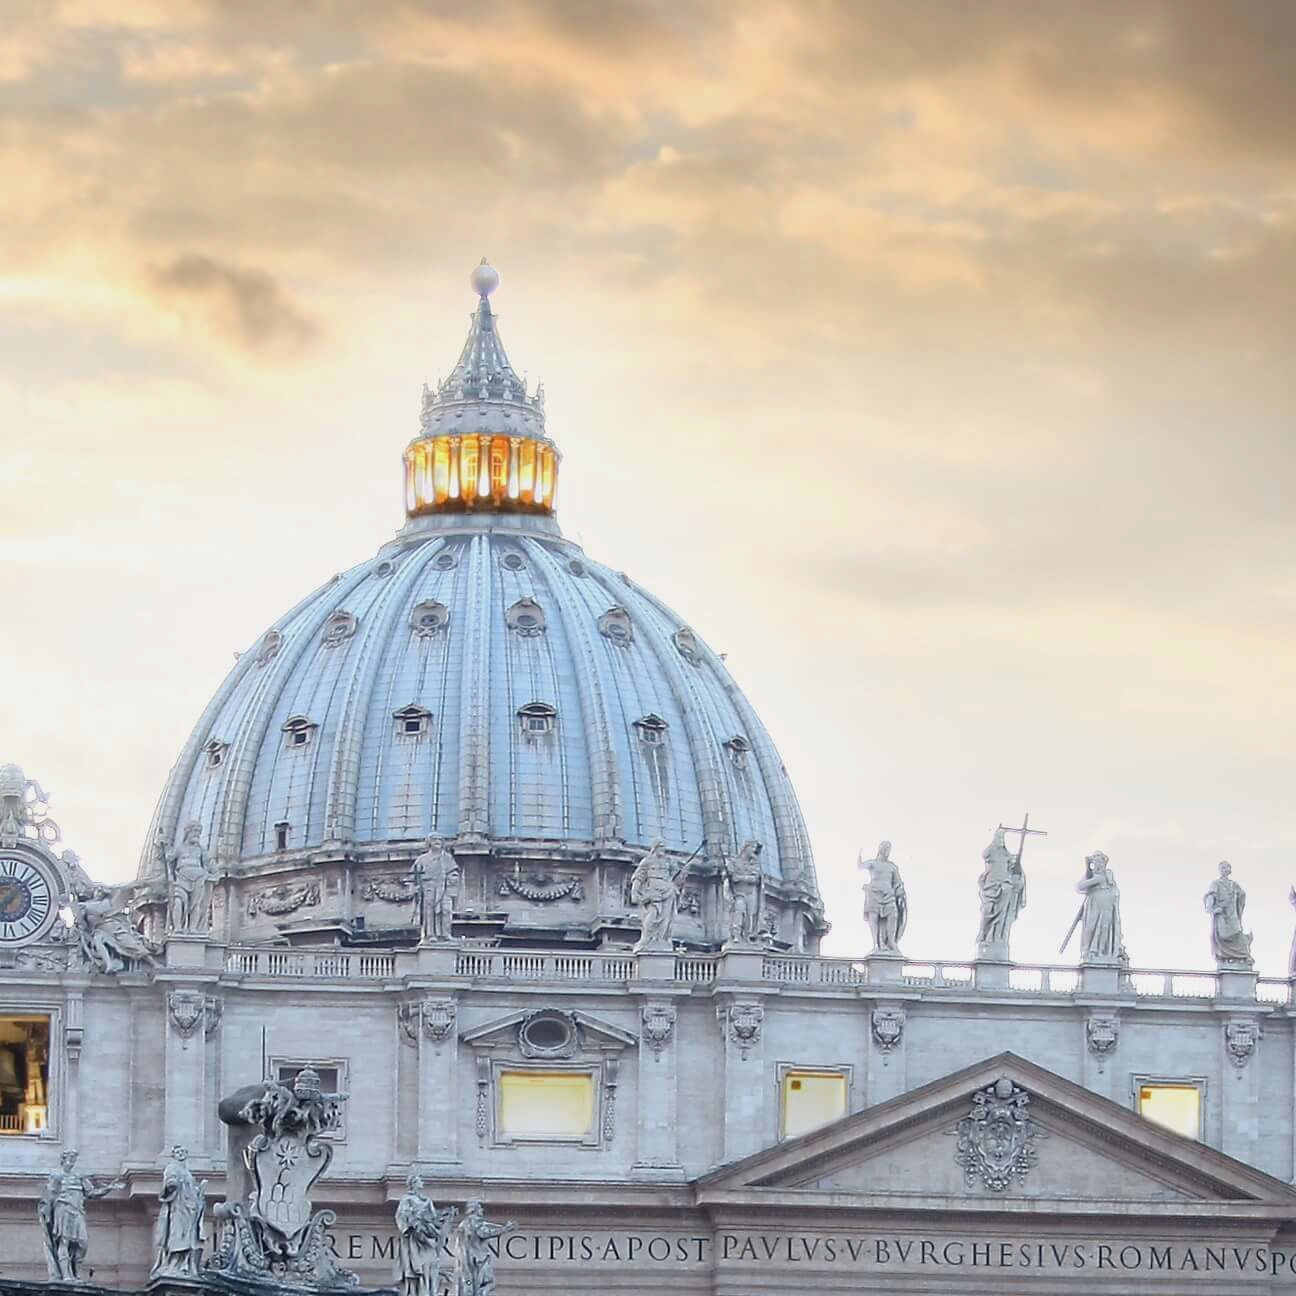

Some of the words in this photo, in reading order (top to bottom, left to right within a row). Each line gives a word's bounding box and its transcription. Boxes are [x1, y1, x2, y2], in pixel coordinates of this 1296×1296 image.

[444, 1234, 594, 1261] NCIPIS
[603, 1236, 710, 1262] APOST
[722, 1235, 836, 1263] PAVLVS
[843, 1238, 867, 1262] V
[875, 1239, 1086, 1269] BVRGHESIVS
[1097, 1244, 1267, 1273] ROMANVS
